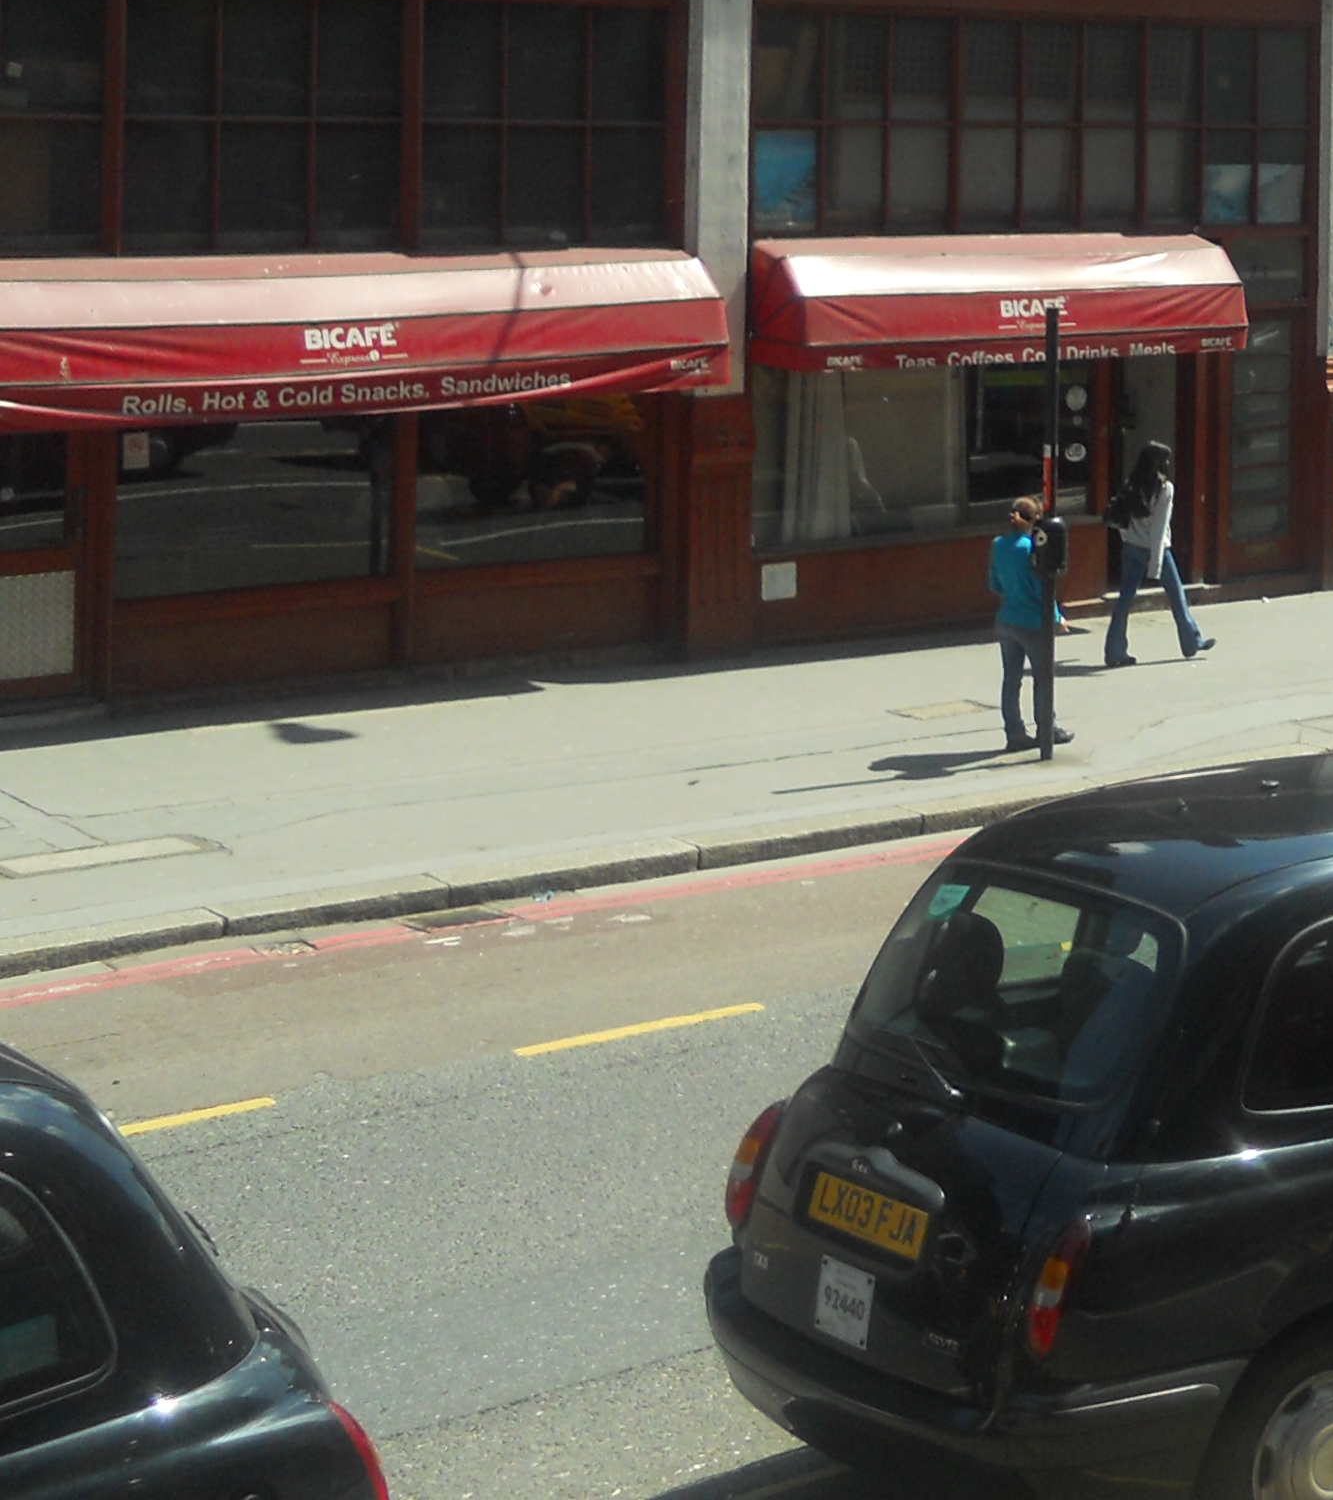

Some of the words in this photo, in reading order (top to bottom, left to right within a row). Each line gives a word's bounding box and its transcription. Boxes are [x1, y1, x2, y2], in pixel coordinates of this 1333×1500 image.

[122, 394, 193, 415] Rolls,
[203, 391, 246, 410] Hot
[252, 389, 270, 409] &
[278, 386, 333, 406] Cold
[441, 371, 571, 395] Sandwiches
[818, 1178, 875, 1228] LX03
[875, 1203, 920, 1248] FJA
